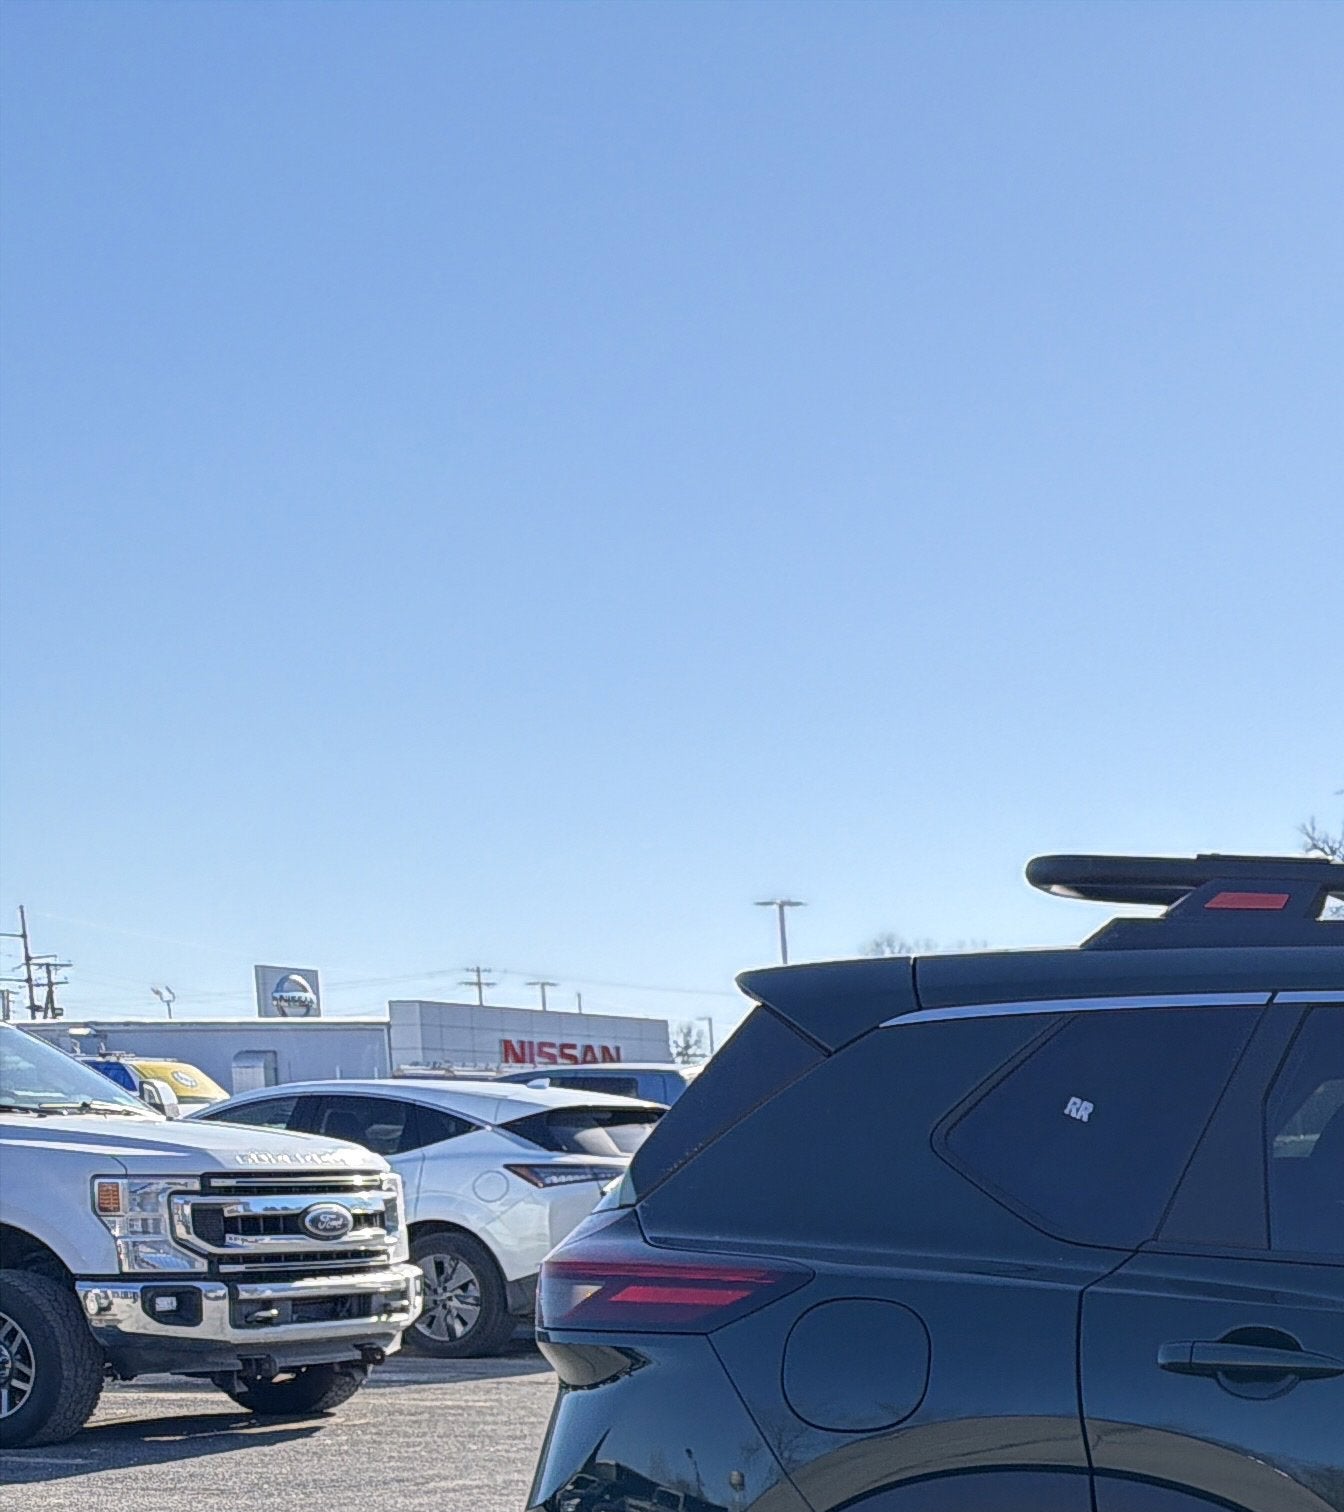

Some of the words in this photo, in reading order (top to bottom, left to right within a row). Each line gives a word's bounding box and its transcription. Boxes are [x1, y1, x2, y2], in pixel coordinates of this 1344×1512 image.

[500, 1039, 621, 1066] NISSAN
[1064, 1096, 1094, 1122] RR
[317, 1214, 344, 1229] Ford
